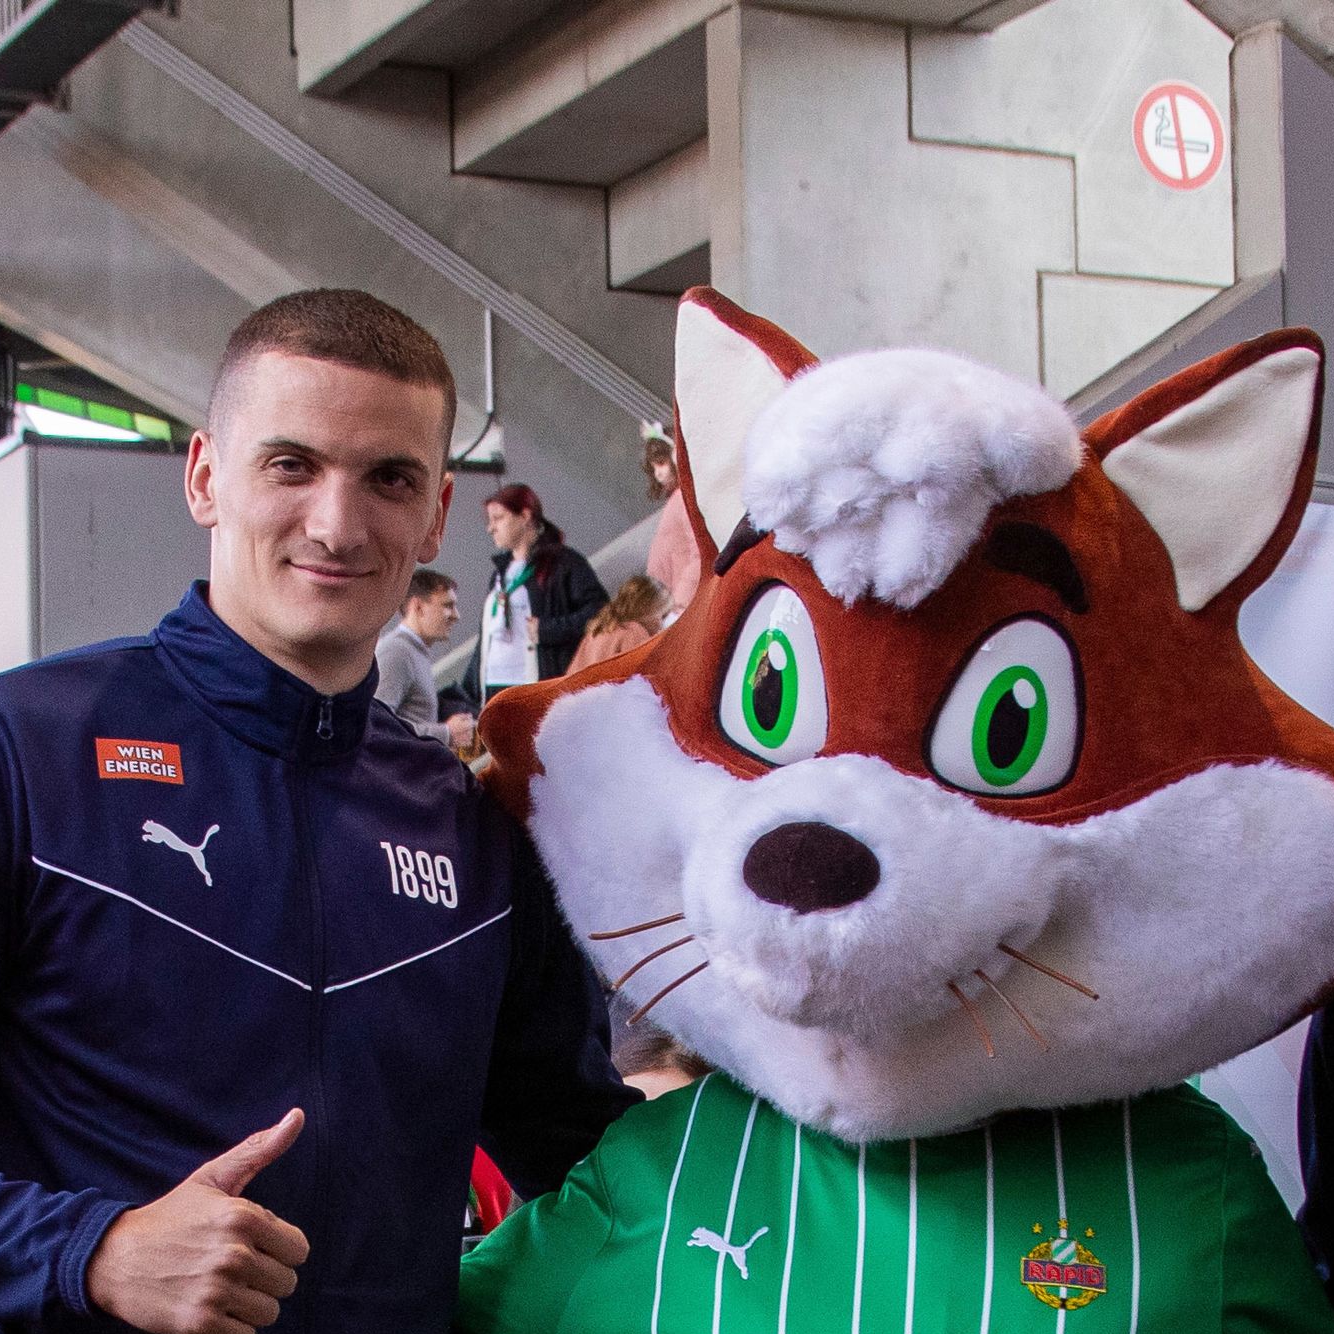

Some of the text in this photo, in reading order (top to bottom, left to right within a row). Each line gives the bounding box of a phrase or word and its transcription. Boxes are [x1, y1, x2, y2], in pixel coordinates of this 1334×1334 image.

[116, 745, 164, 761] WIEN
[105, 760, 178, 778] ENERGIE
[380, 841, 458, 909] 1899
[1028, 1260, 1102, 1285] RAPID
